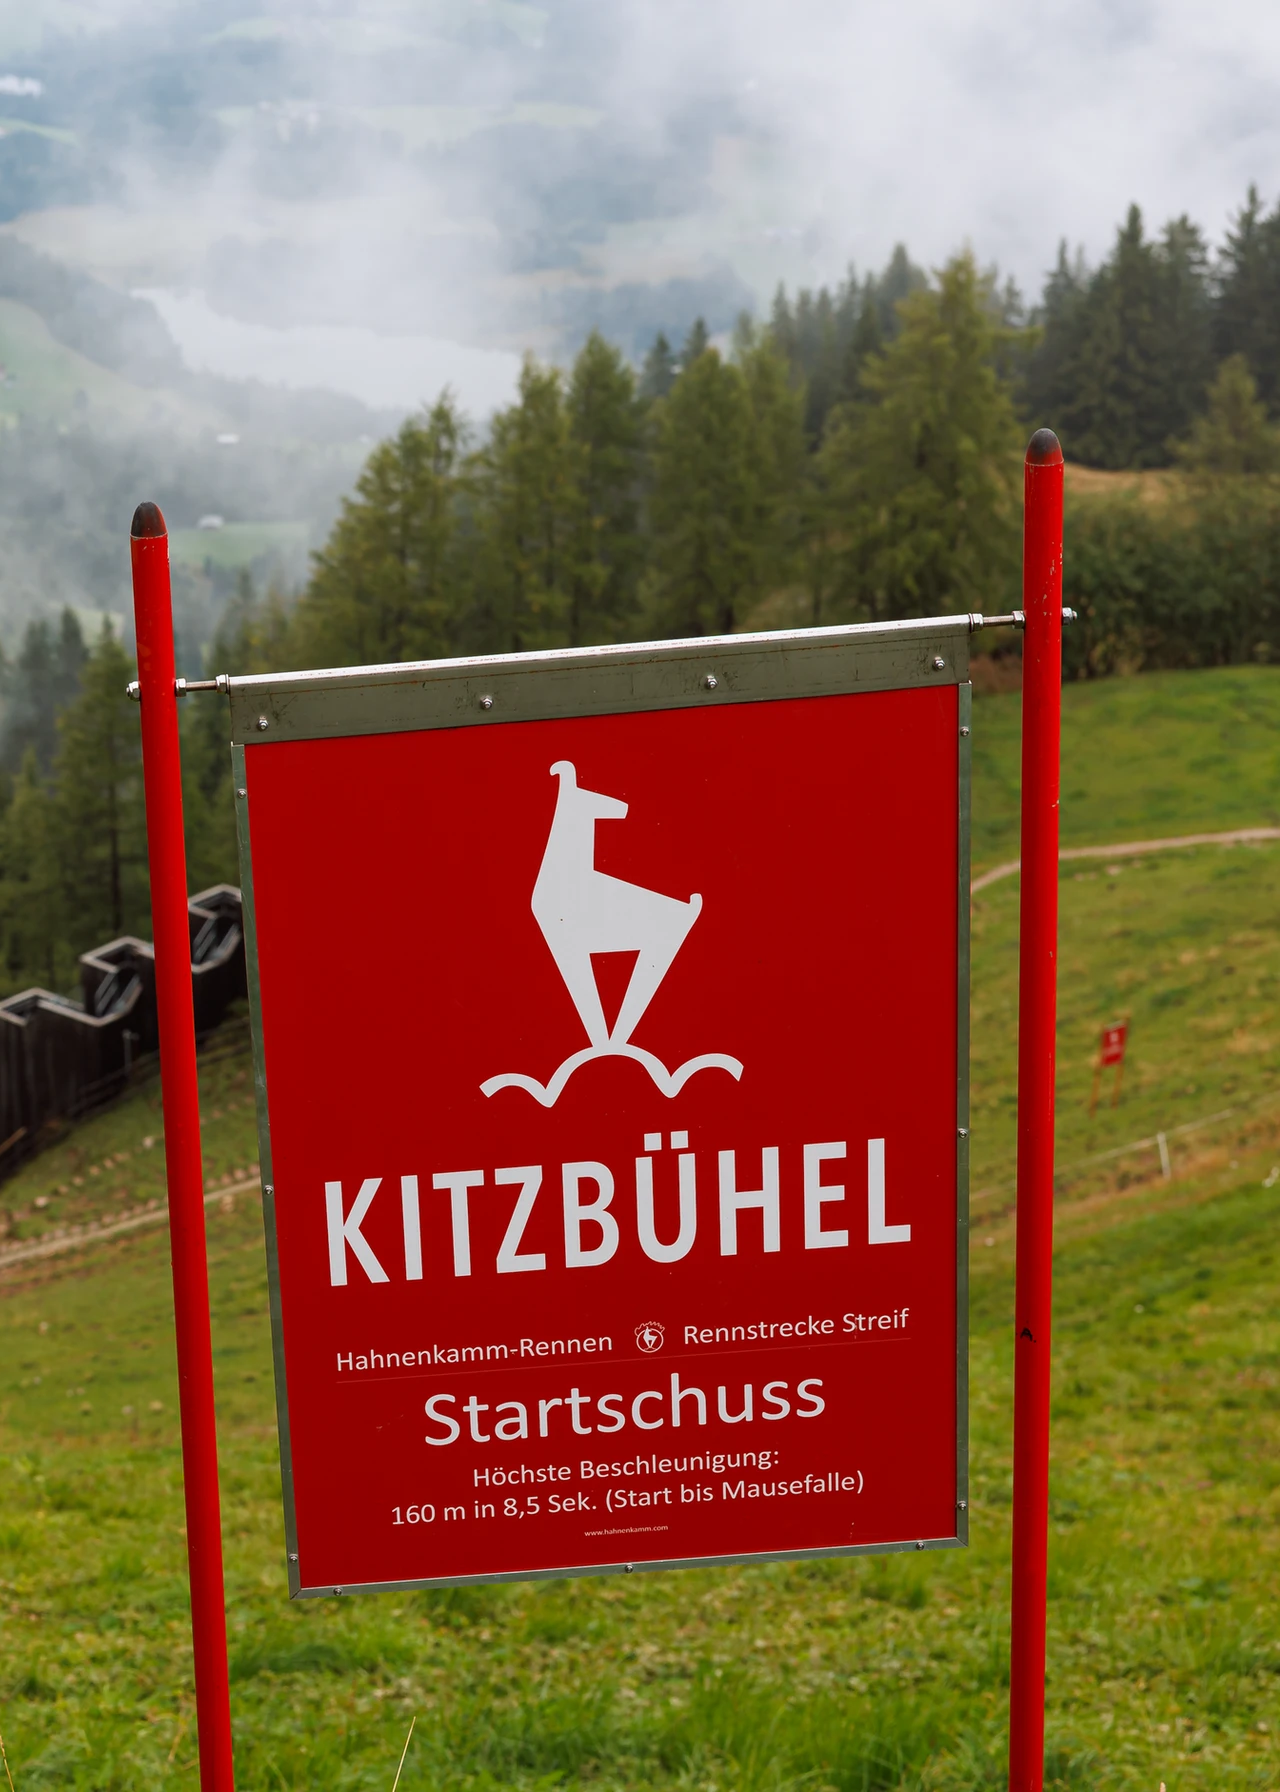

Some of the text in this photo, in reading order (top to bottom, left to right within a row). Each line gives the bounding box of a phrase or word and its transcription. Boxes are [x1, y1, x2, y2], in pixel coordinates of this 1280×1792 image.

[324, 1130, 912, 1287] KITZBÜHEL
[336, 1307, 910, 1372] Hahnenkamm-Rennen Rennstrecke Streif
[424, 1372, 826, 1447] Startschuss
[391, 1469, 864, 1525] 160 m in 8,5 Sek. (Start bis Mausefalle)
[473, 1450, 779, 1488] Höchste Beschleunigung:
[584, 1525, 669, 1537] www.hahnenkamm.com
